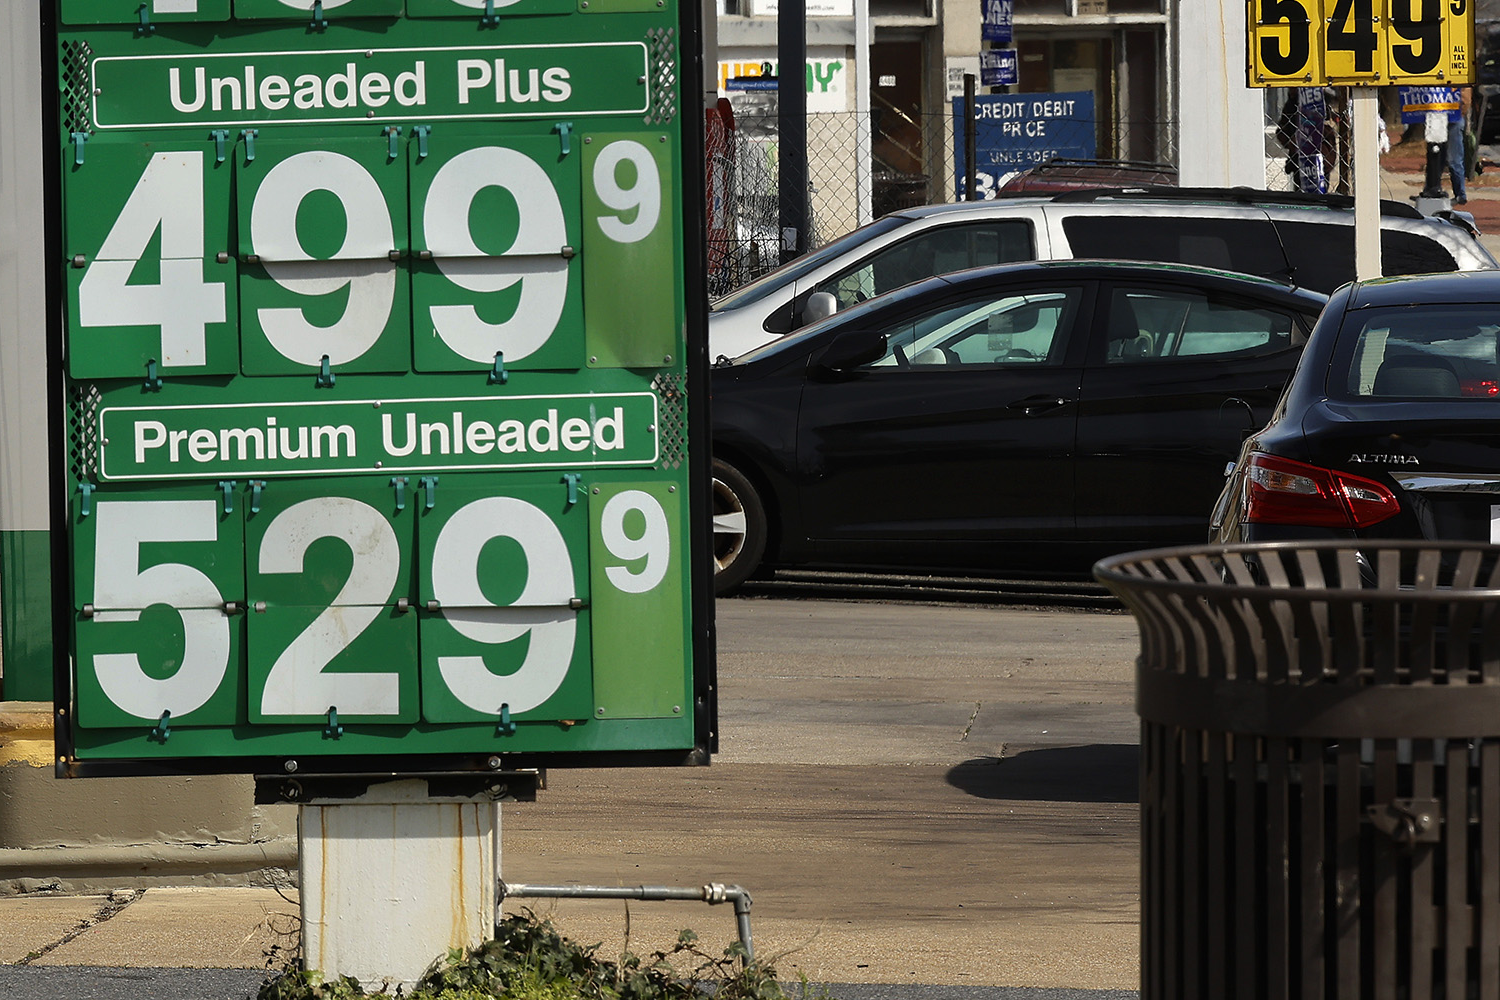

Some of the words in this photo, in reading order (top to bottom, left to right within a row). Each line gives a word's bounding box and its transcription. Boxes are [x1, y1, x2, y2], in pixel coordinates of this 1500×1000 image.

[1453, 45, 1465, 53] ALL
[1453, 53, 1465, 61] TAX
[168, 61, 427, 113] Unleaded
[456, 58, 573, 104] Plus
[1400, 91, 1461, 105] THOMAS
[1002, 120, 1046, 137] PRCE
[79, 146, 569, 368] 499
[592, 140, 662, 244] 9
[133, 415, 357, 464] Premium
[381, 406, 626, 458] Unleaded
[1348, 453, 1420, 465] ALTIMA
[91, 495, 577, 720] 529
[600, 489, 671, 594] 9
